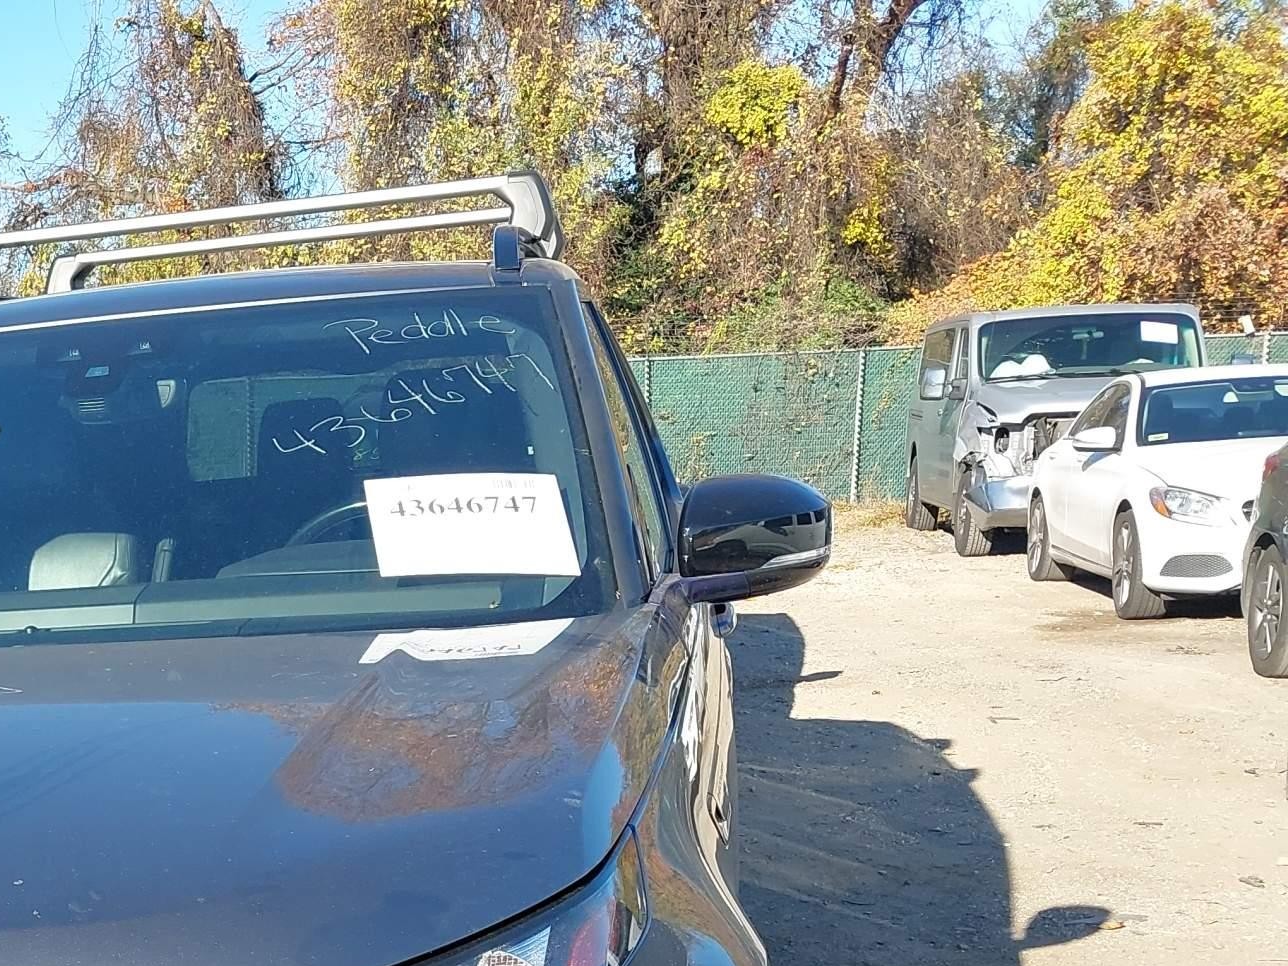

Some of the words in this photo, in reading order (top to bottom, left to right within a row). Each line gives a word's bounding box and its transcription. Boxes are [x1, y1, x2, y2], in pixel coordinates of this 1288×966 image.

[322, 308, 516, 354] Peddle
[272, 353, 554, 454] 43646747
[390, 496, 537, 517] 43646747
